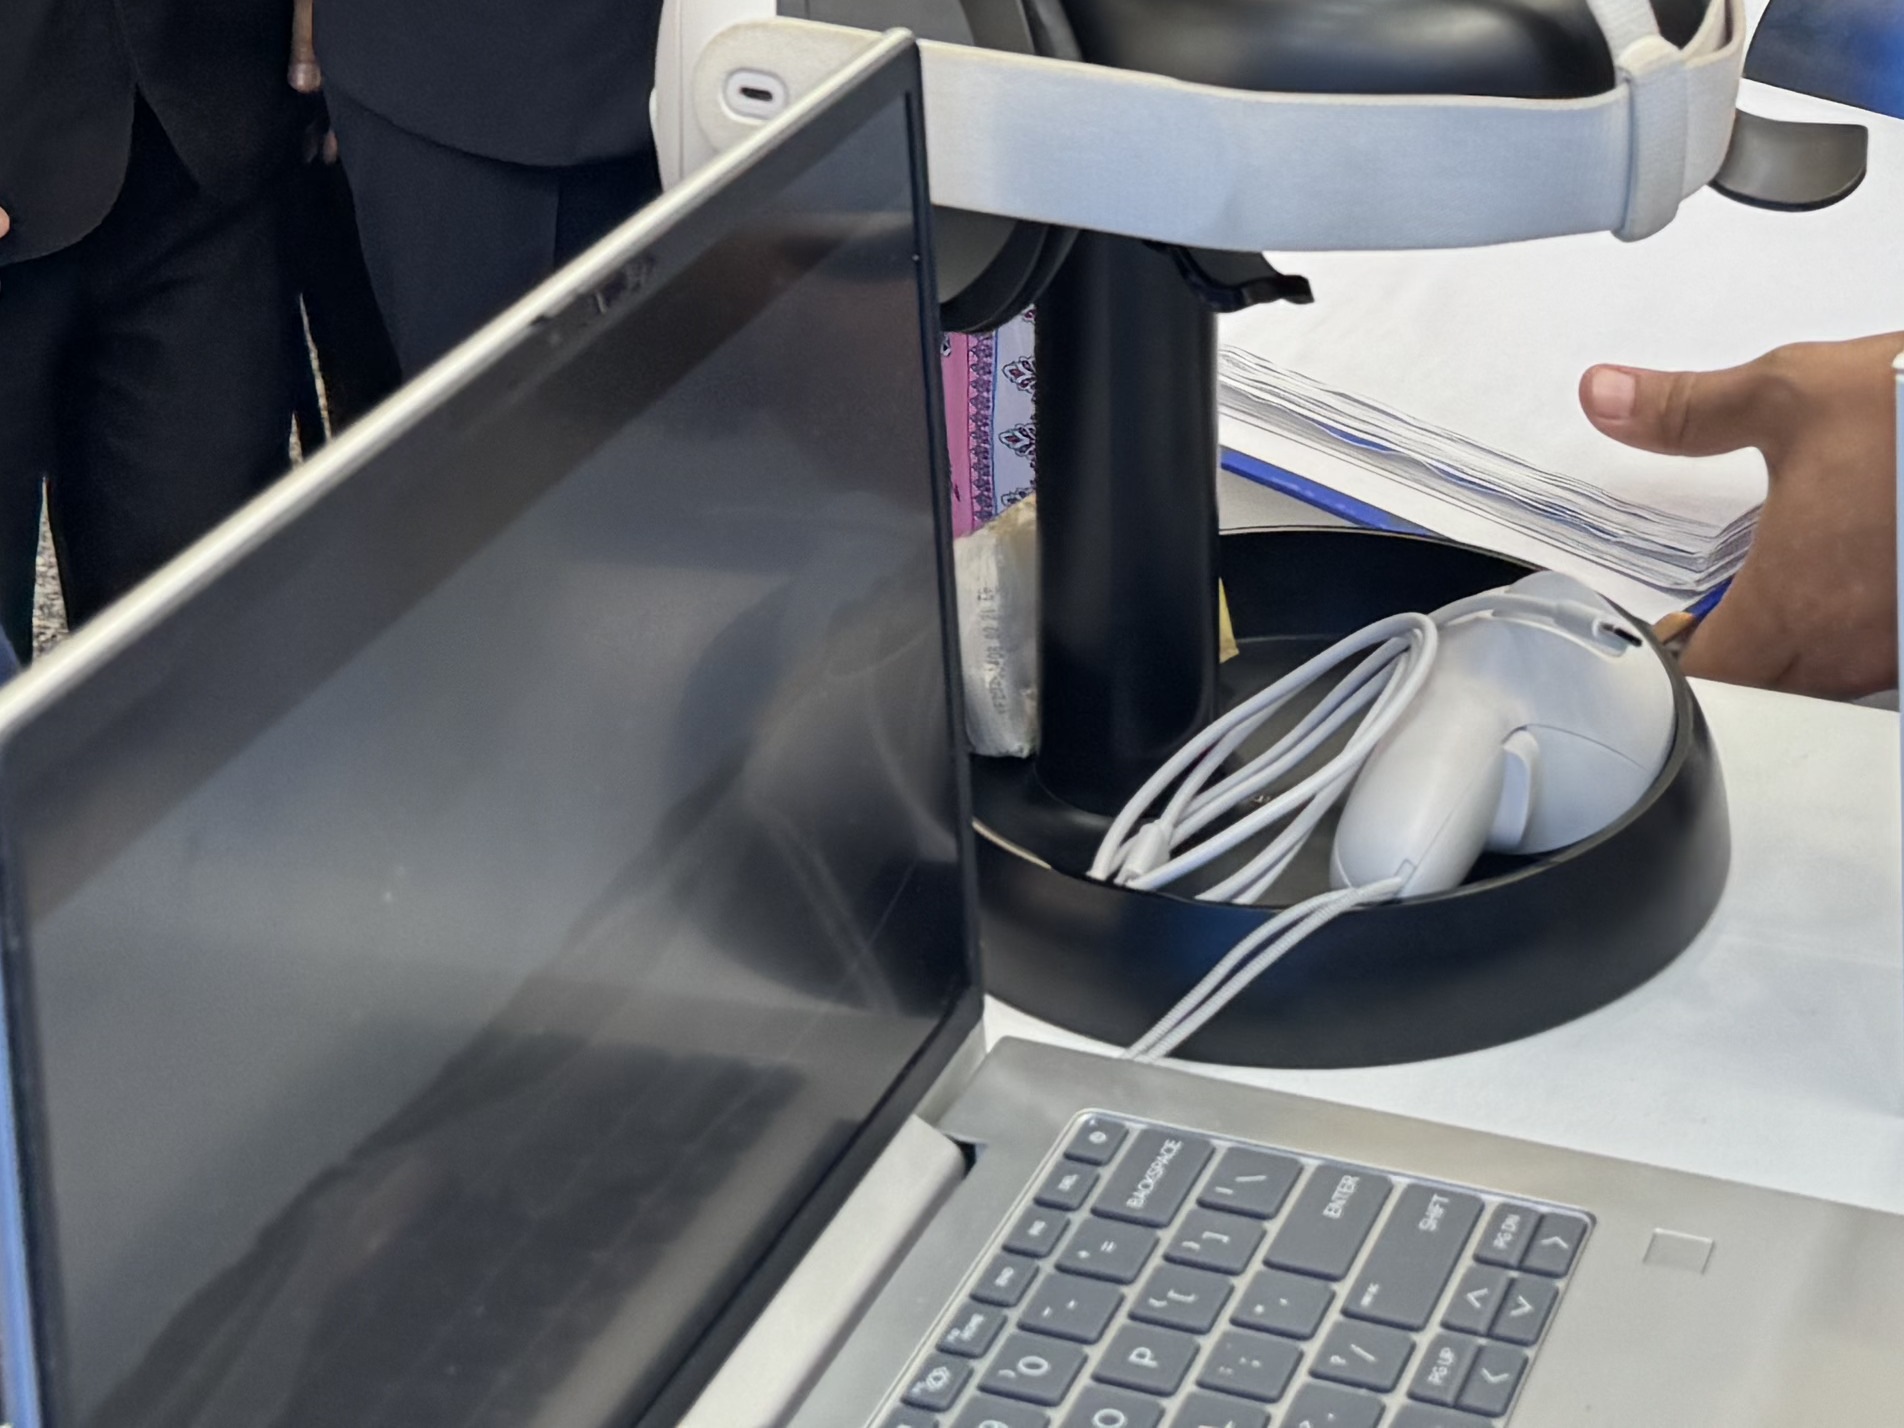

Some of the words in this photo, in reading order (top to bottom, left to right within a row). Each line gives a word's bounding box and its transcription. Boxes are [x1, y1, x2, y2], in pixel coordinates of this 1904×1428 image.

[1126, 1138, 1183, 1208] BACKSPACE
[1322, 1174, 1360, 1219] ENTER
[1418, 1193, 1450, 1232] SHIFT
